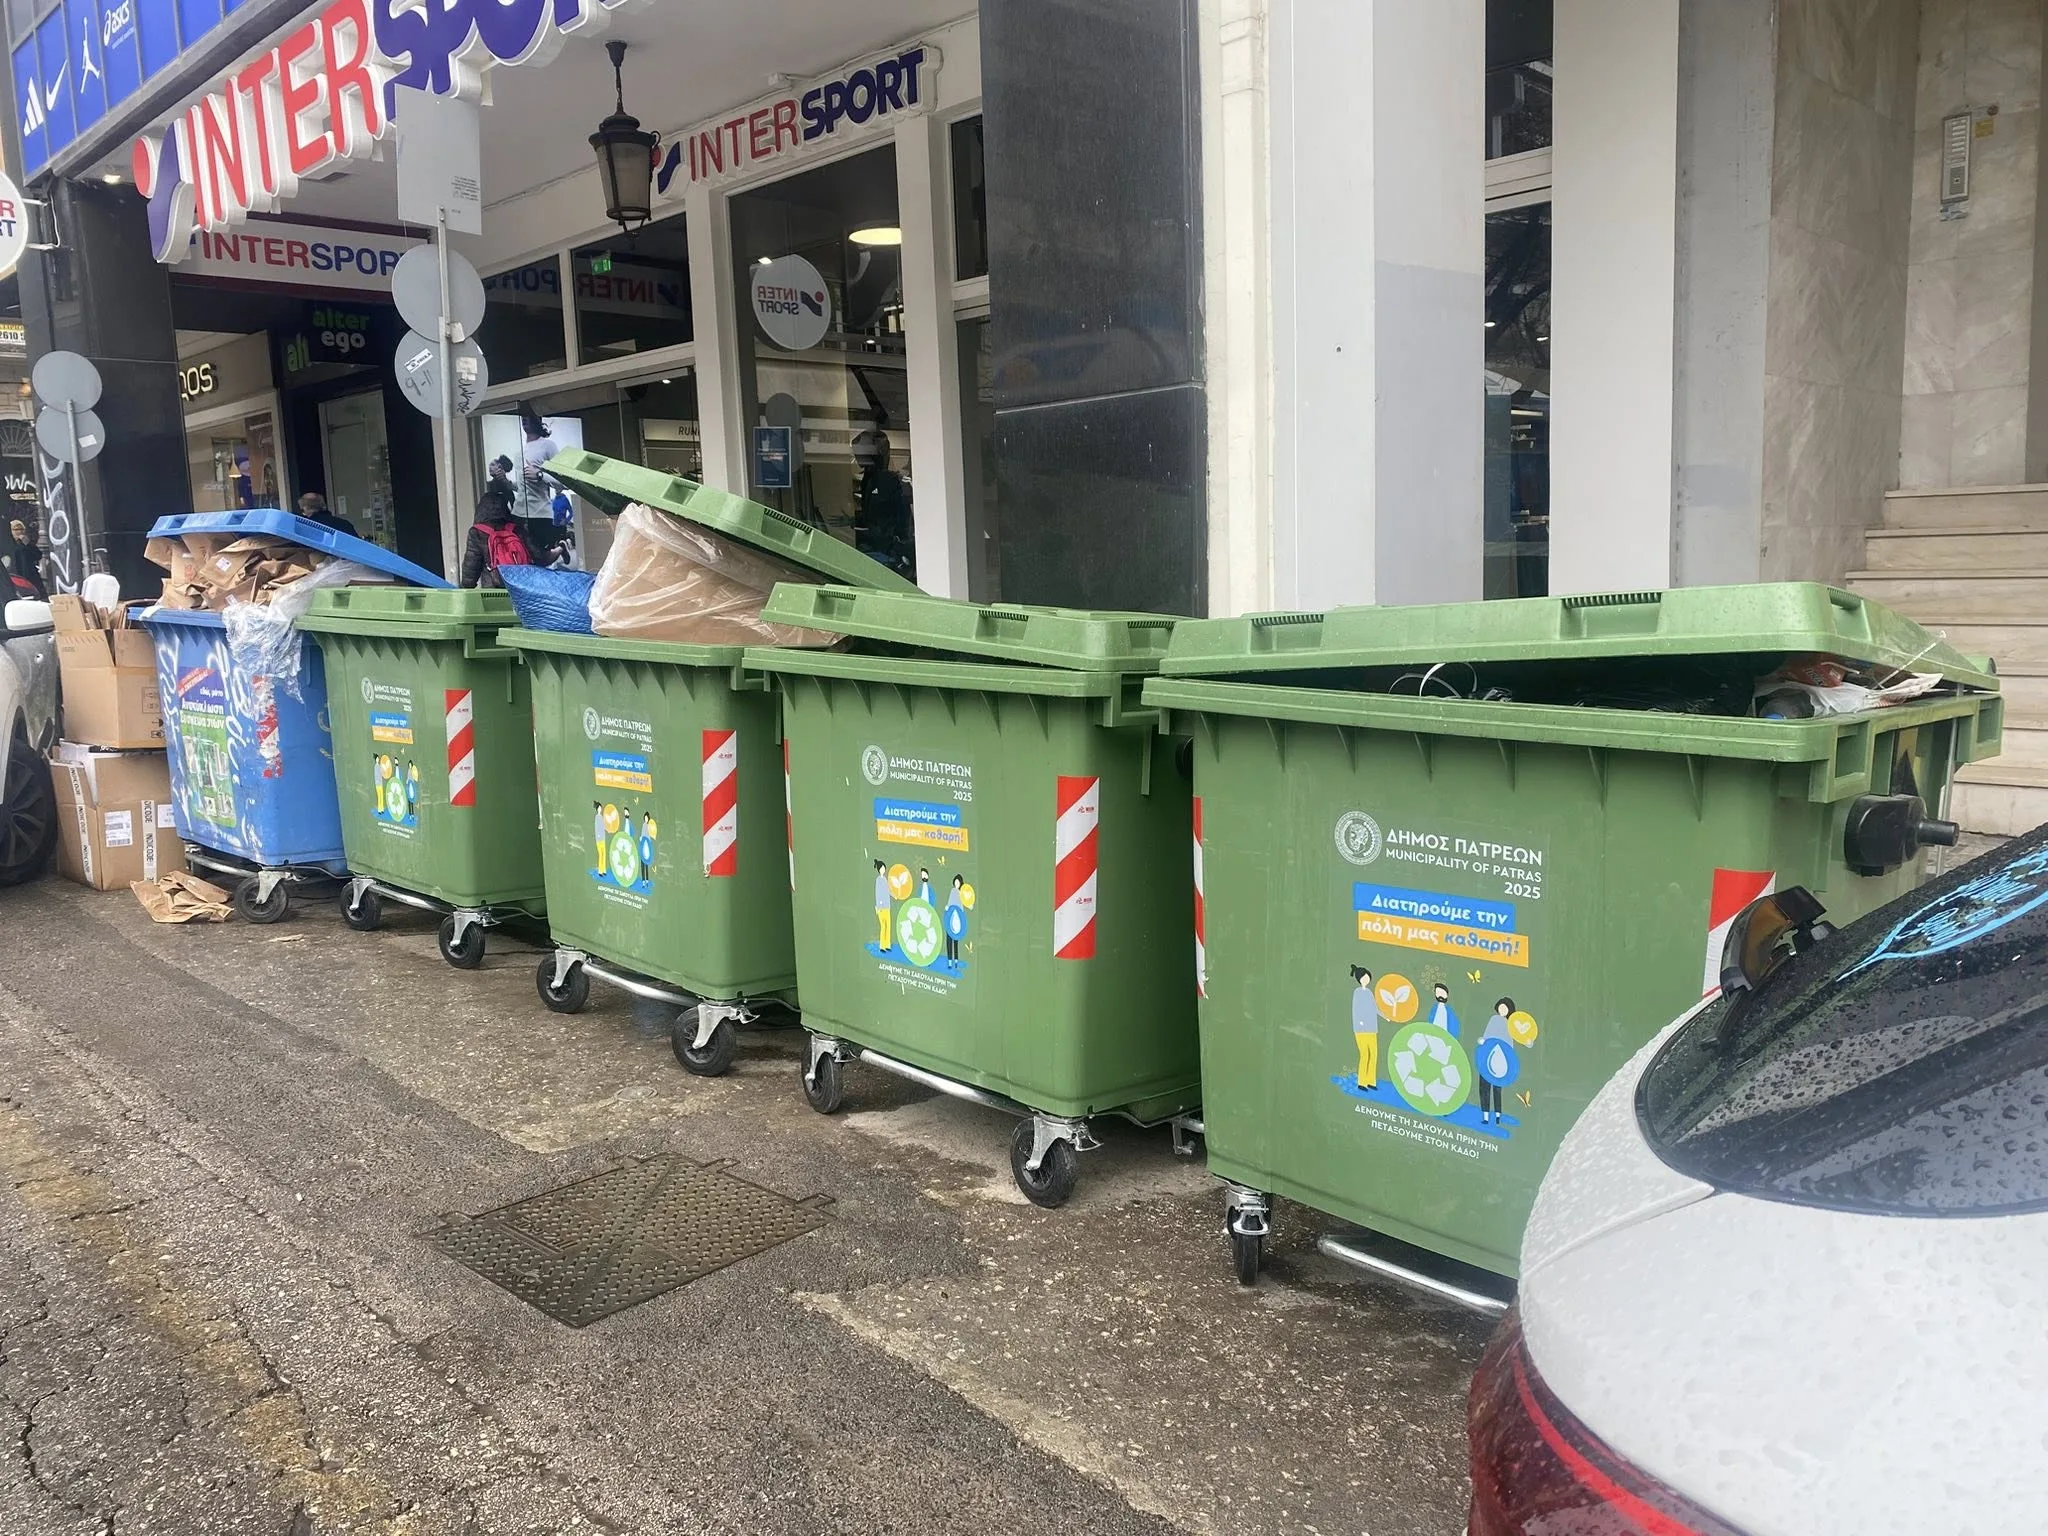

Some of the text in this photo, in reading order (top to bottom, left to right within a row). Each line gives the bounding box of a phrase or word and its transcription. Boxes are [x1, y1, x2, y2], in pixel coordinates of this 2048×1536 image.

[689, 48, 924, 182] INTERSPORT
[201, 231, 405, 276] INTERSPOR
[313, 305, 370, 330] alter
[321, 330, 366, 354] ego
[889, 757, 972, 777] ΔΗΜΟΣ ΠΑΤΡΕΩΝ
[889, 771, 972, 790] MUNICIPALITY OF PATRAS
[953, 790, 973, 802] 2025
[883, 805, 957, 824] Διατηρούμε την
[879, 824, 903, 838] πόλη
[1386, 828, 1542, 866] ΔΗΜΟΣ ΠΑΤΡΕΩΝ
[1386, 848, 1542, 883] MUNICIPALITY OF PATRAS
[1504, 882, 1541, 899] 2025
[1371, 893, 1508, 928] Διατηρούμε την
[1362, 917, 1520, 958] πόλη μας καθαρή!
[1354, 1104, 1498, 1153] ΔΕΝΟΥΜΕ ΤΗ ΣΑΚΟΥΛΑ ΠΡΙΝ ΤΗΝ
[1371, 1120, 1480, 1160] ΠΕΤΑΞΟΥΜΕ ΣΤΟΝ ΚΑΔΟ!
